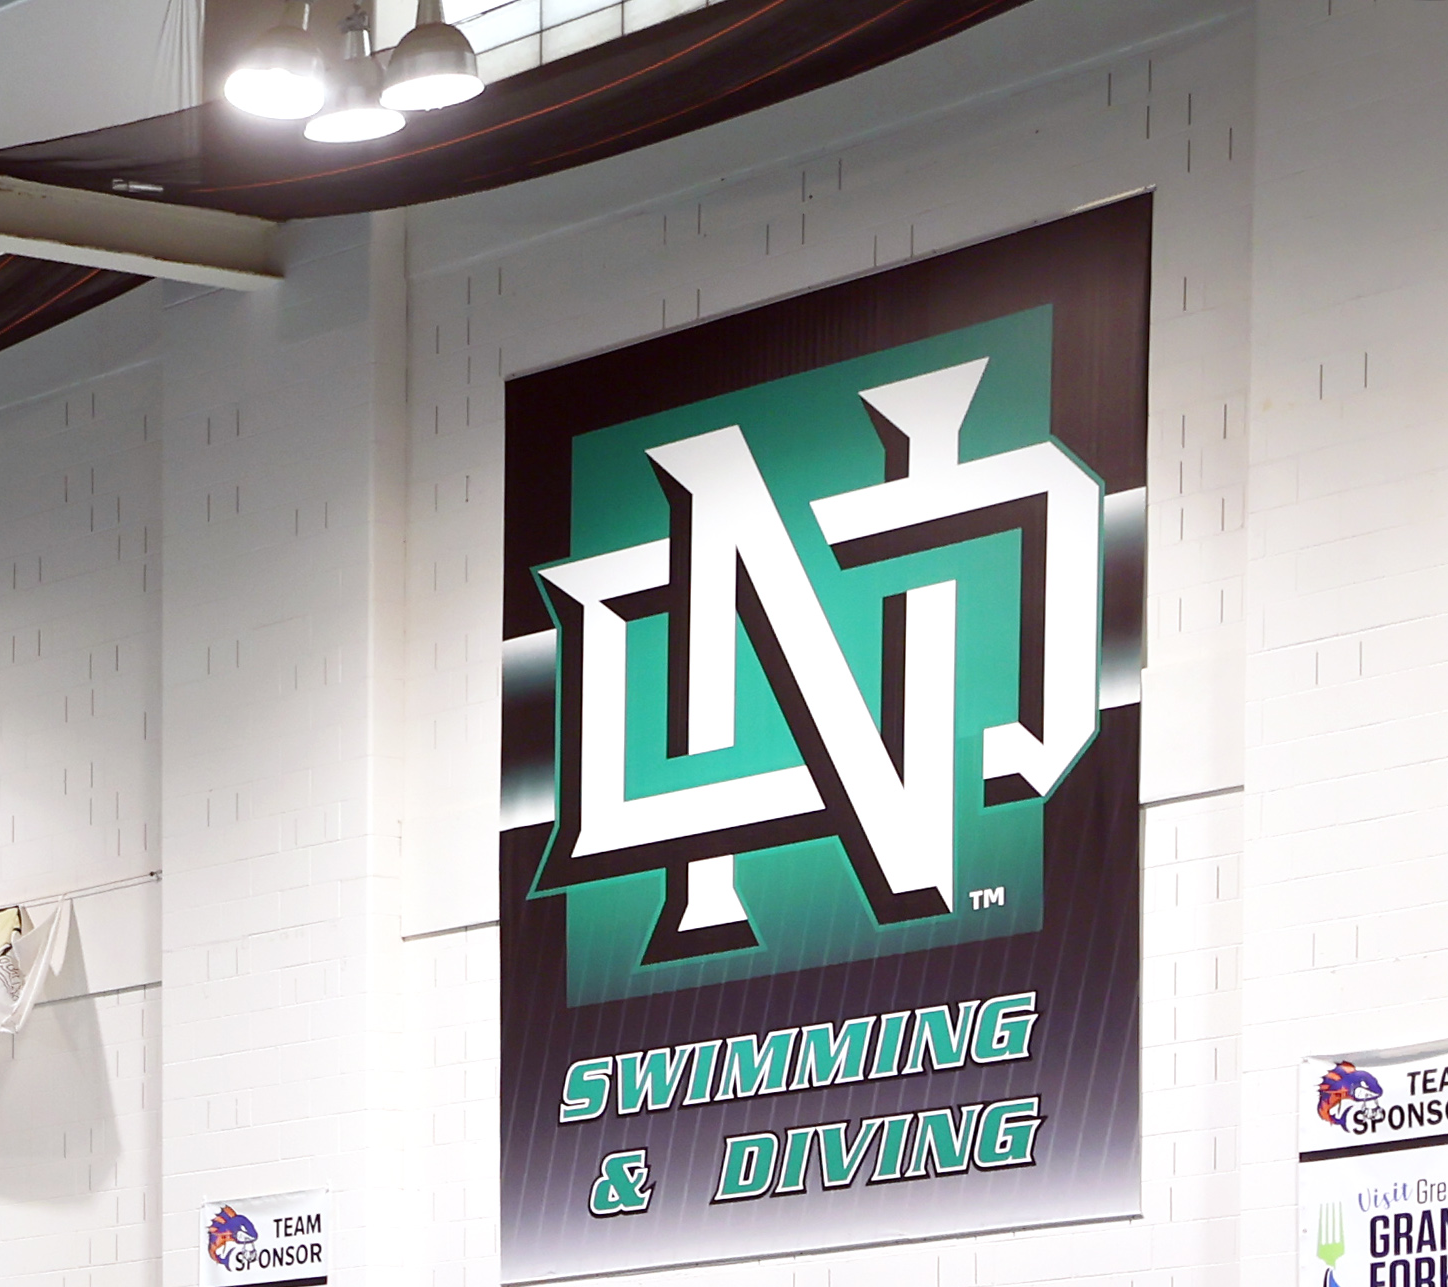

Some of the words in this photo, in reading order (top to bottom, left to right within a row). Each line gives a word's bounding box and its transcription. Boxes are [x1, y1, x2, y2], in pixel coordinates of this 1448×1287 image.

[970, 887, 1004, 910] TM
[559, 991, 1037, 1124] SWIMMING
[1407, 1070, 1448, 1096] TEA
[1353, 1099, 1448, 1136] SPONS
[588, 1150, 651, 1219] &
[712, 1096, 1046, 1206] DIVING
[1357, 1182, 1413, 1213] Visit
[274, 1214, 322, 1239] TEAM
[236, 1243, 322, 1271] SPONSOR
